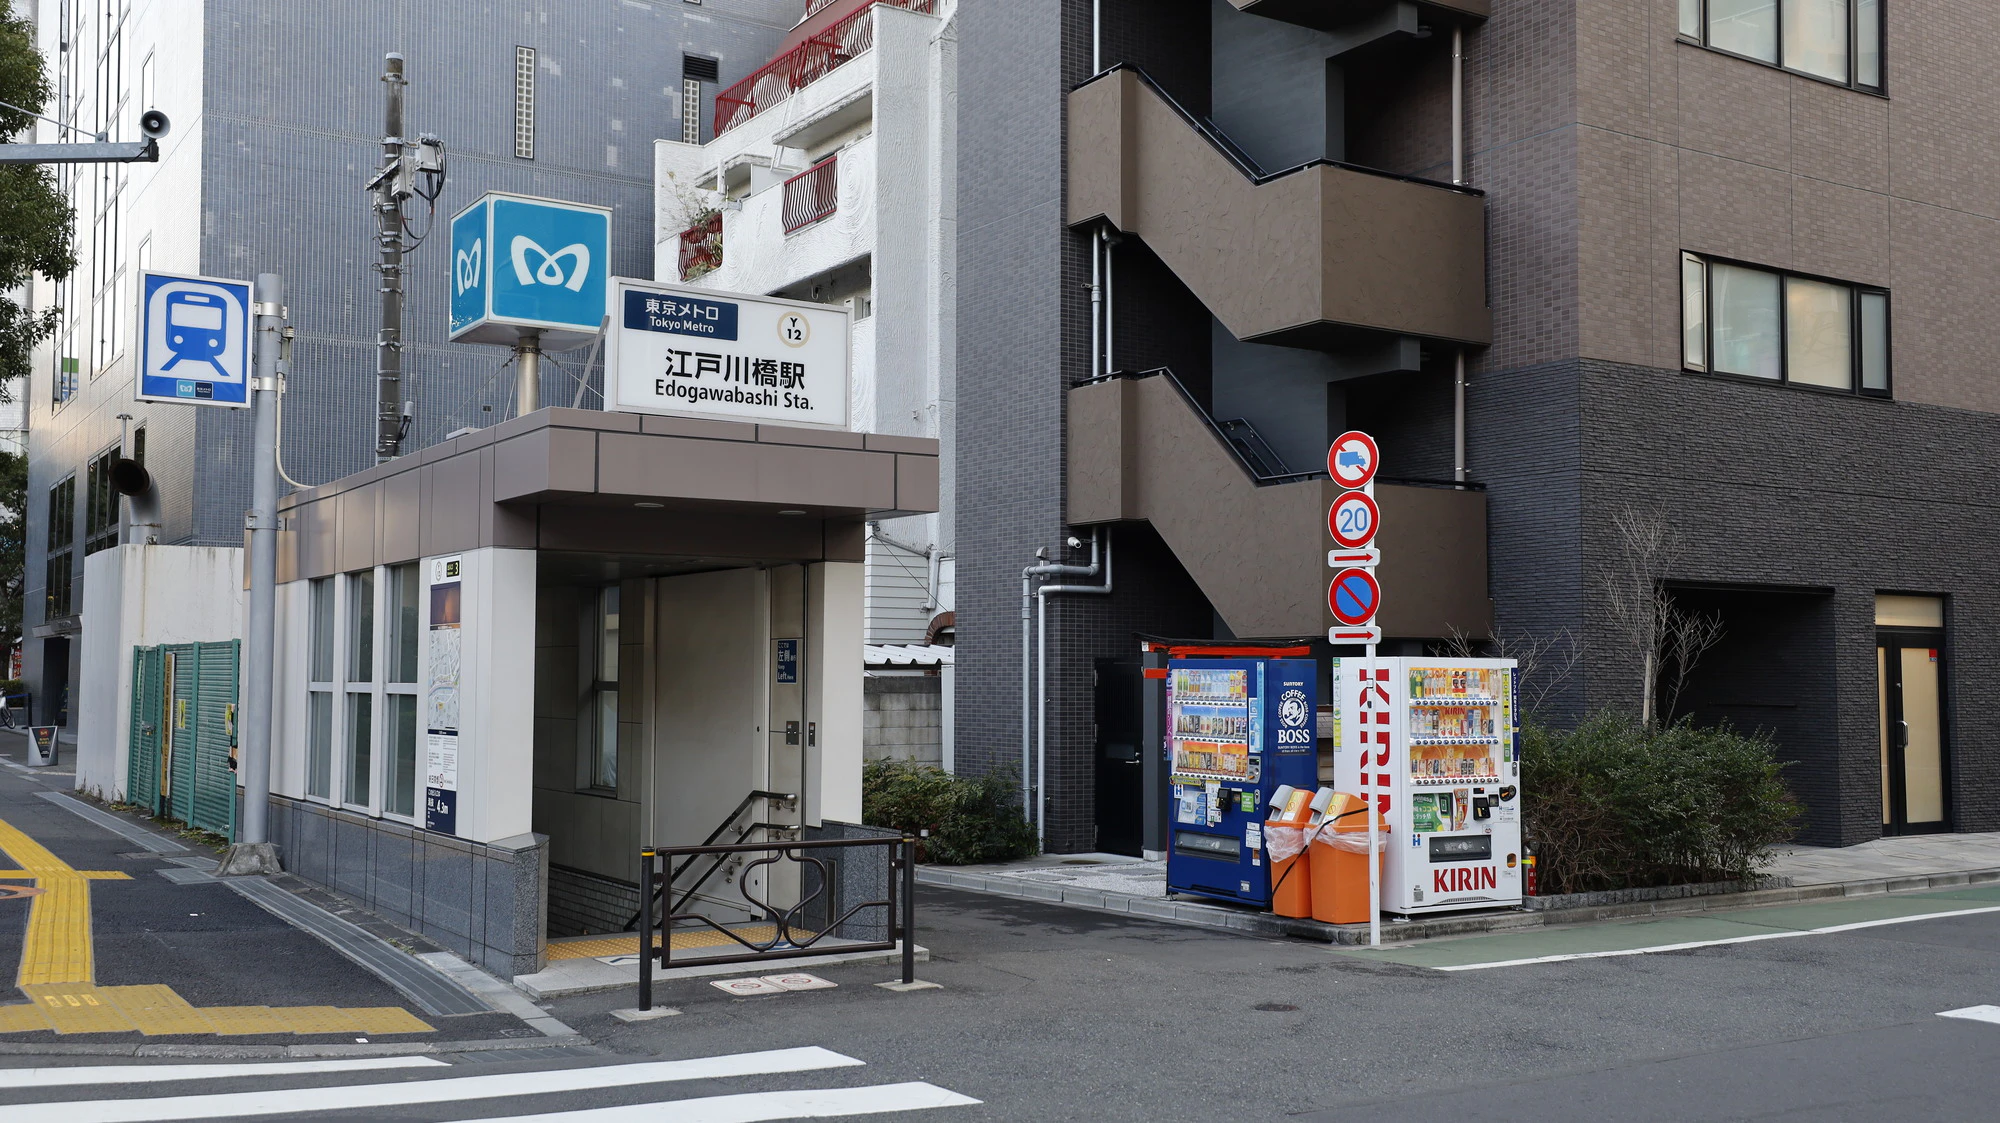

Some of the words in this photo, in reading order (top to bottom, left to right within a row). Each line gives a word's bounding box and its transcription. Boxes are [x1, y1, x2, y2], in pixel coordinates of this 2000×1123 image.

[644, 298, 719, 321] 東京メトロ
[650, 315, 681, 331] Tokyo
[683, 319, 714, 334] Metro
[789, 317, 798, 328] Y
[787, 328, 802, 341] 12
[665, 348, 806, 390] 江戸川橋駅
[655, 378, 778, 408] Edogawabashi
[784, 391, 814, 411] Sta.
[1340, 507, 1368, 533] 20
[455, 562, 459, 575] 3
[778, 672, 787, 680] Left
[1281, 689, 1307, 702] COFFEE
[1444, 707, 1466, 716] KIRIN
[1277, 729, 1310, 744] BOSS
[436, 799, 449, 815] 4.3m
[1433, 866, 1497, 893] KIRIN
